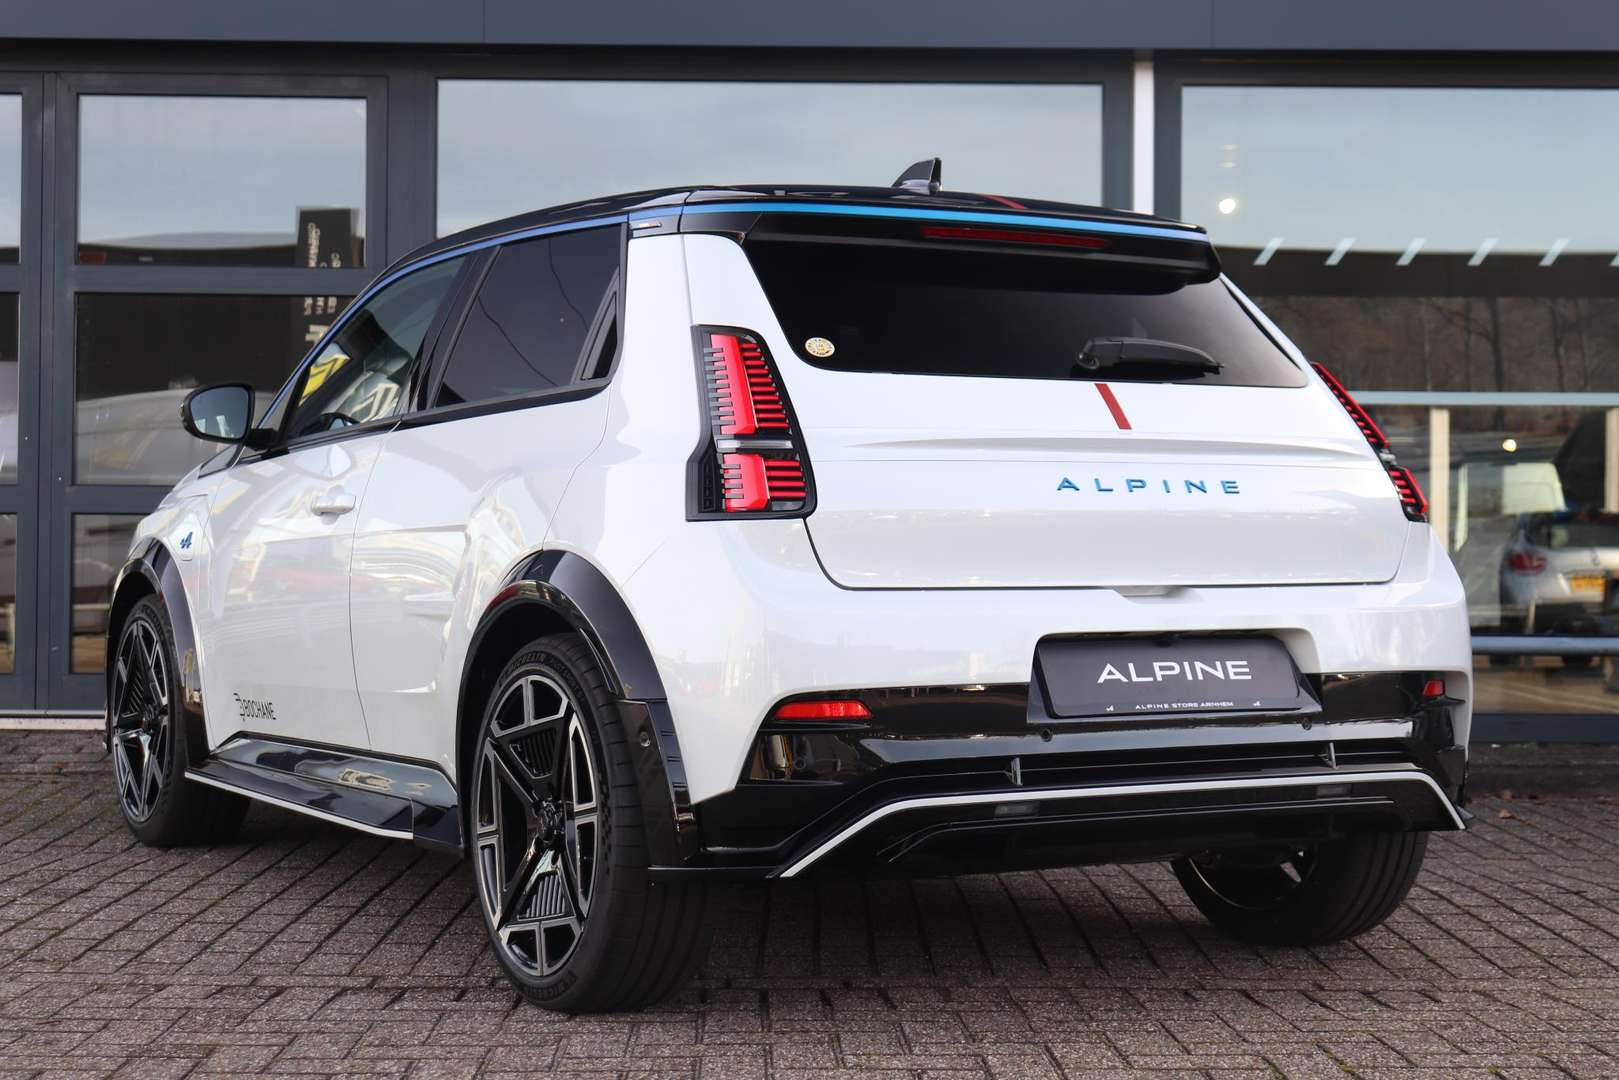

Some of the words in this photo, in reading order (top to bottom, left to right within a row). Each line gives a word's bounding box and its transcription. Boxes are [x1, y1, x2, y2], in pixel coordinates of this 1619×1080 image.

[1056, 476, 1240, 494] ALPINE
[1097, 660, 1252, 684] ALPINE
[242, 698, 276, 720] BOCHANE
